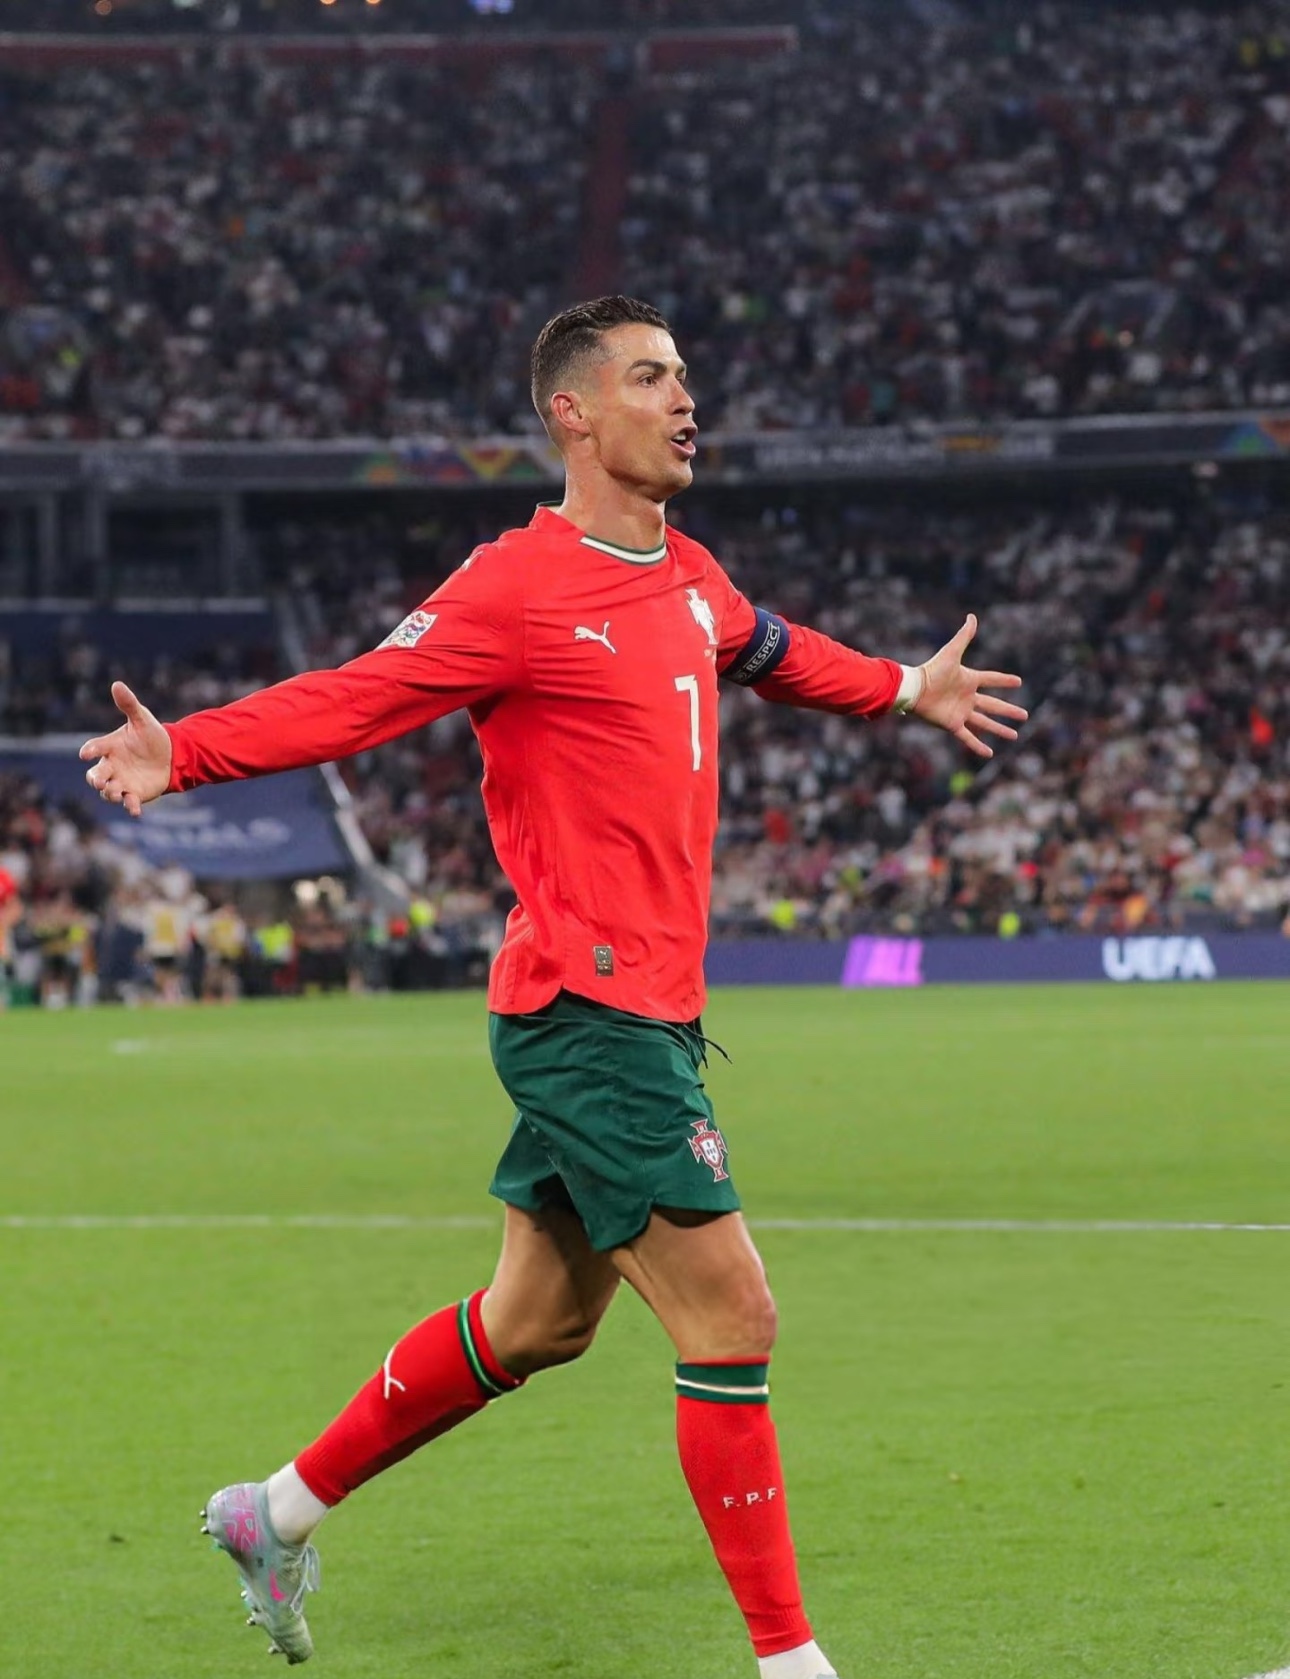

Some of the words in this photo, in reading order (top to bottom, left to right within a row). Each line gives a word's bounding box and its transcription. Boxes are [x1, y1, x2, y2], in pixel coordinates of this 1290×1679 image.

[746, 624, 779, 672] RESPECT
[674, 674, 702, 771] 7
[1102, 936, 1216, 981] UEFA
